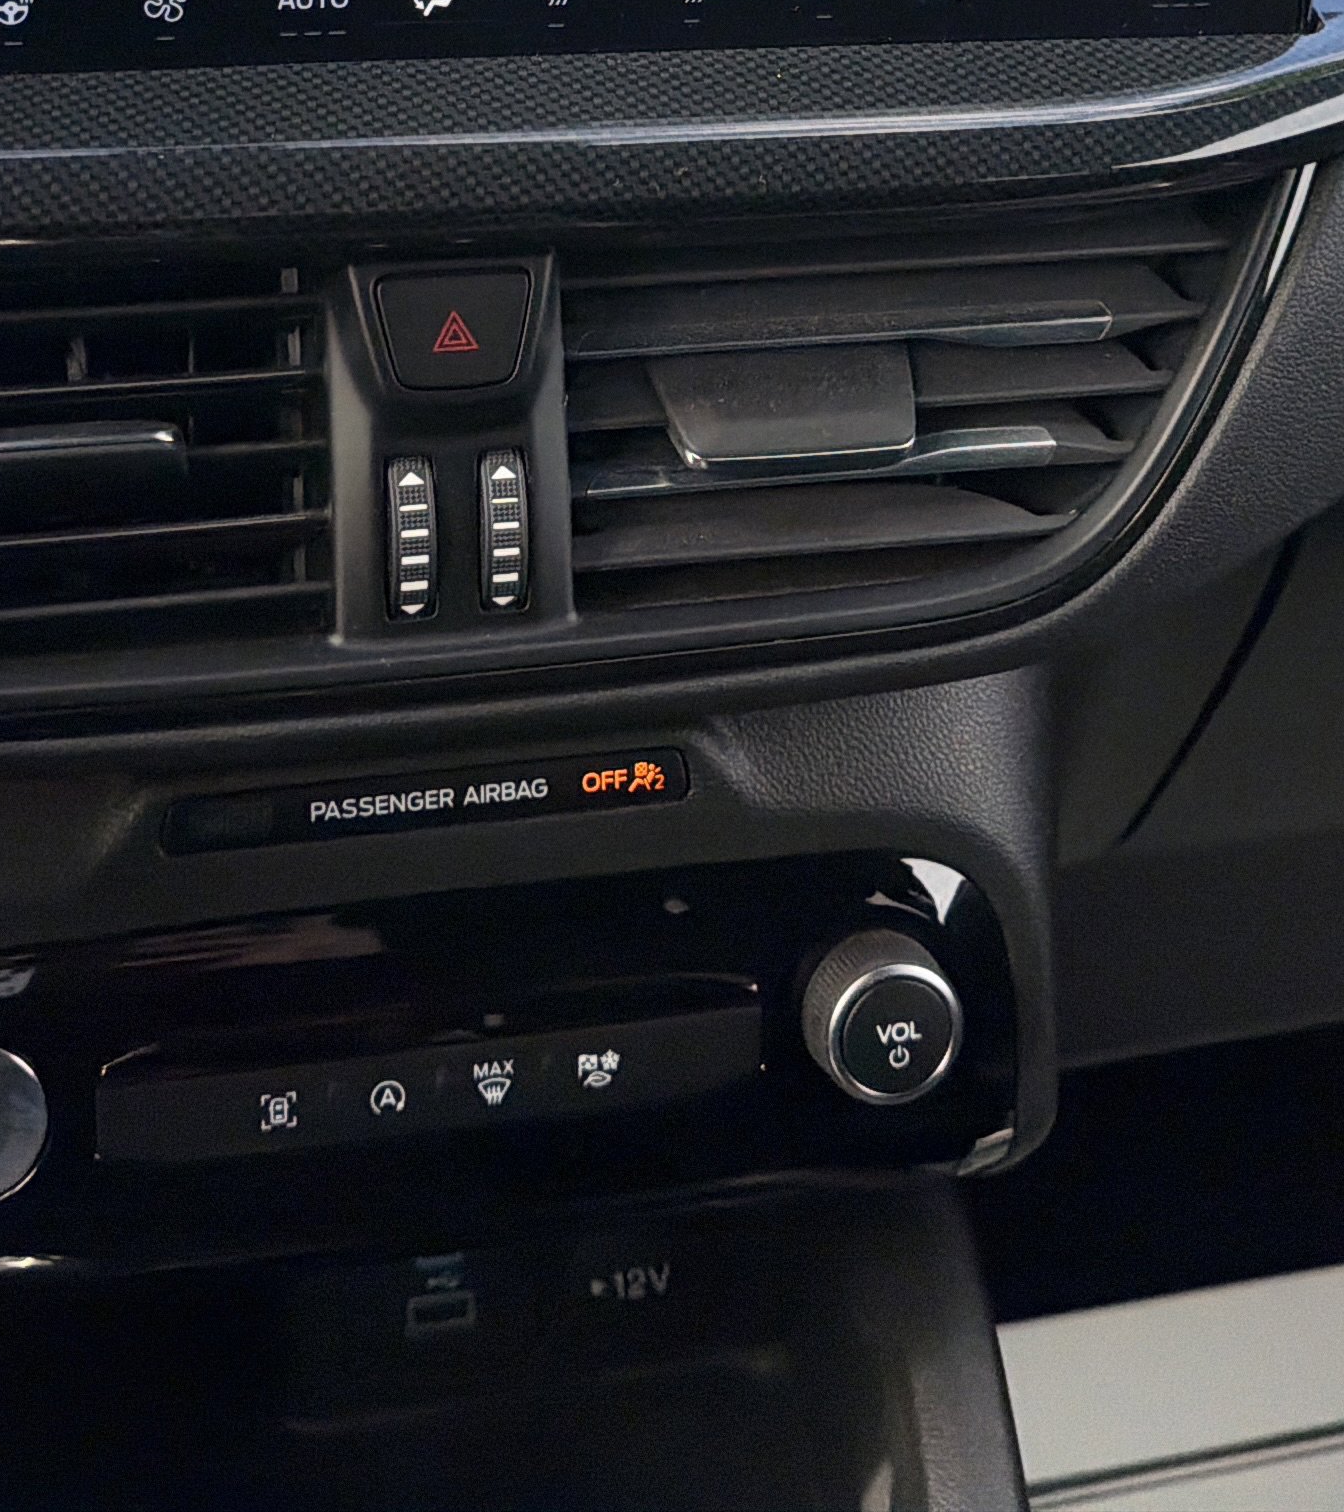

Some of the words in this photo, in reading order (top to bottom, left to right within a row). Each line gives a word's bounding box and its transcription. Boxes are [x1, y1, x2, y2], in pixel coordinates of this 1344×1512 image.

[310, 788, 455, 823] PASSENGER
[463, 778, 549, 806] AIRBAG
[582, 769, 628, 793] OFF
[876, 1020, 923, 1045] VOL
[473, 1059, 514, 1079] MAX
